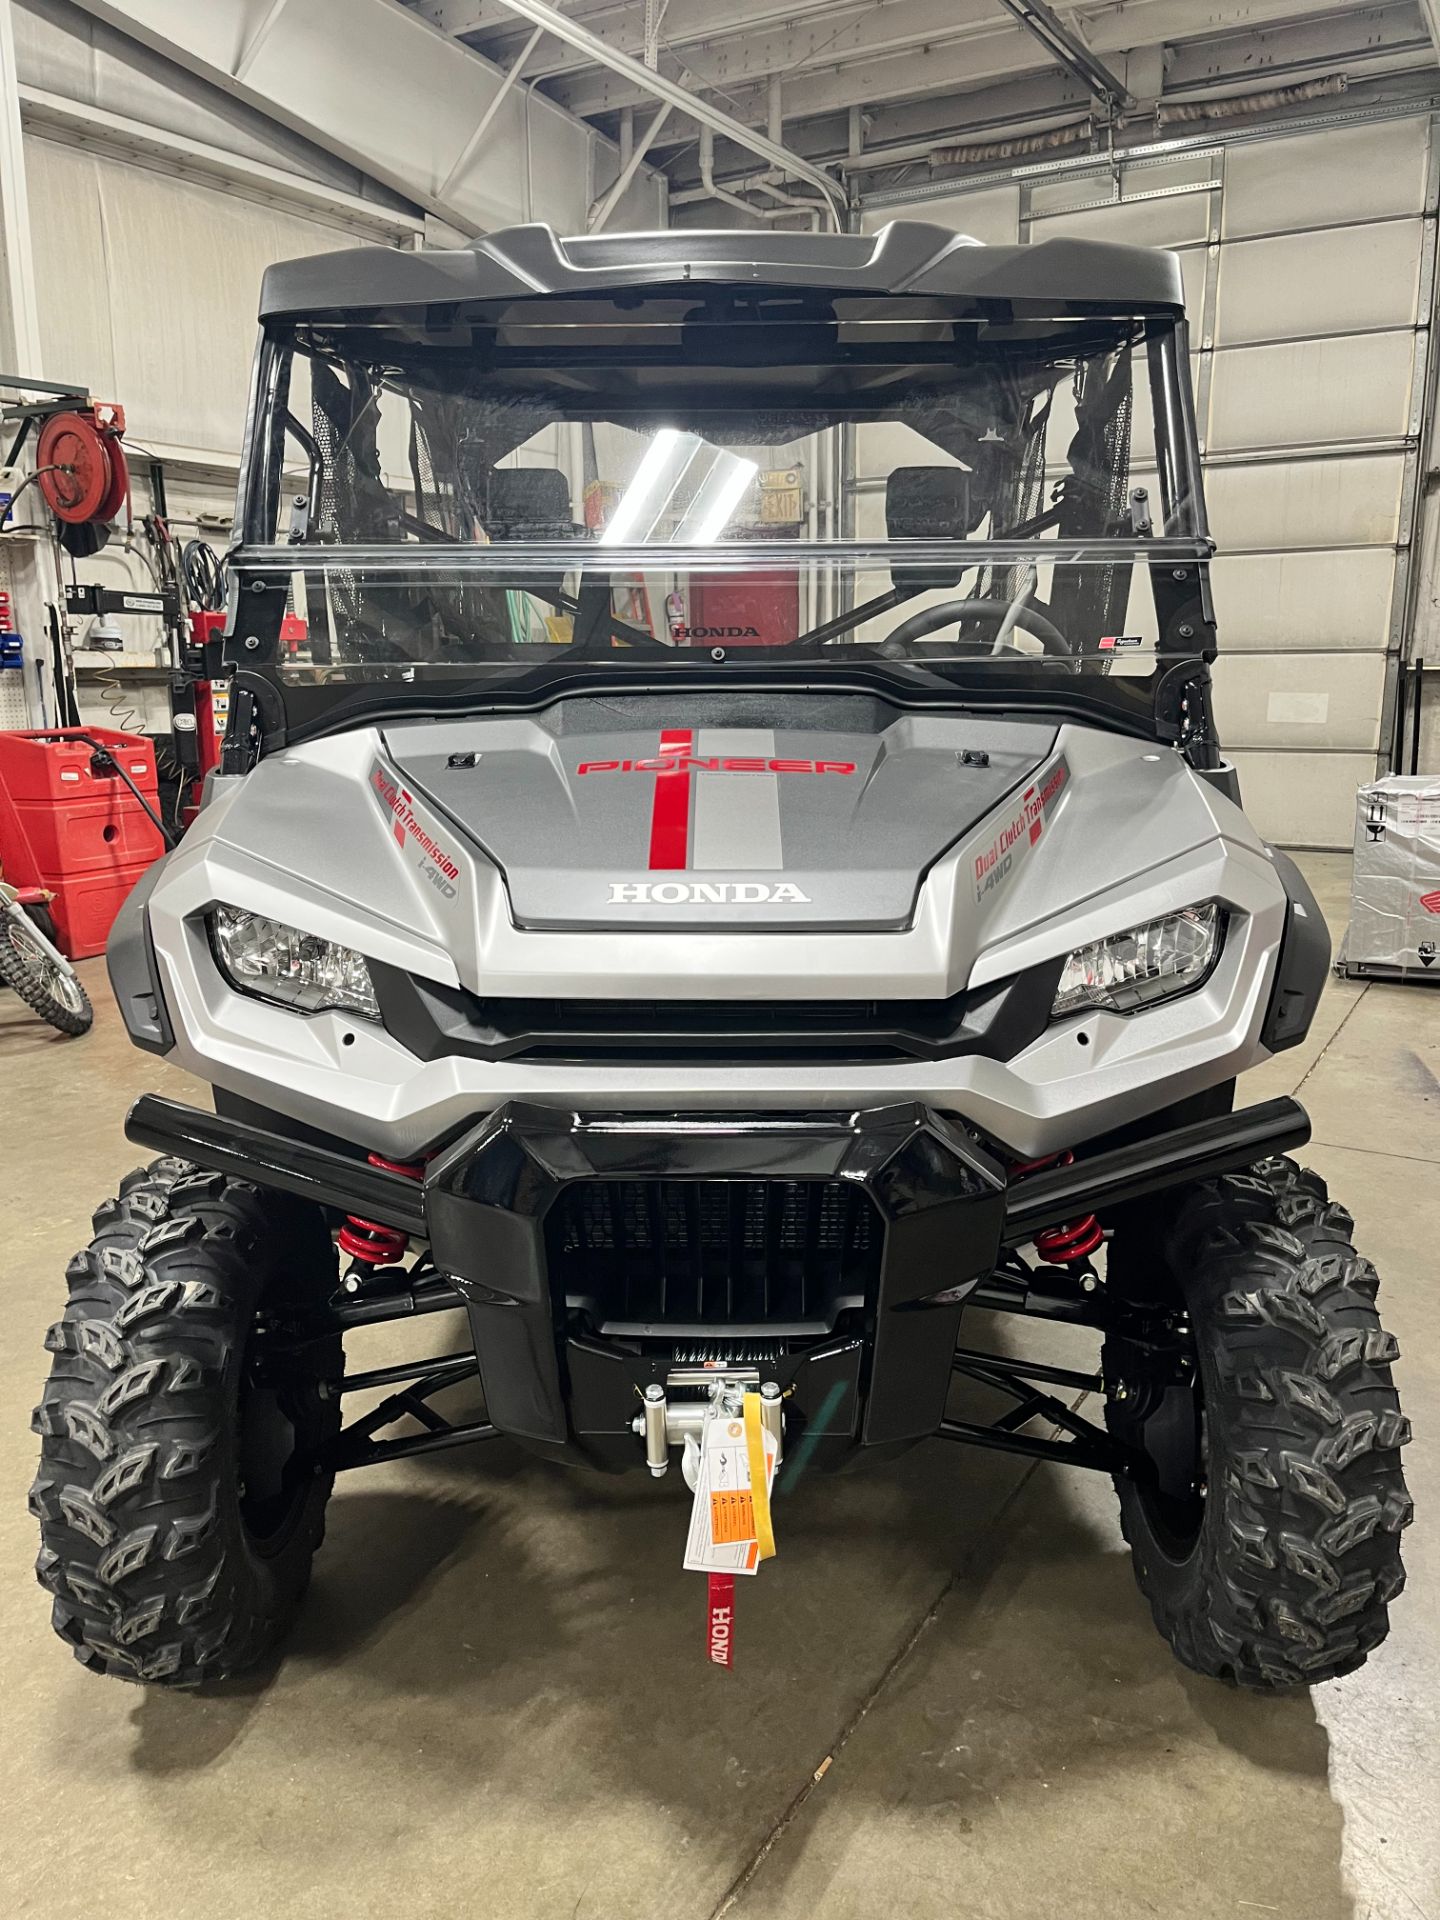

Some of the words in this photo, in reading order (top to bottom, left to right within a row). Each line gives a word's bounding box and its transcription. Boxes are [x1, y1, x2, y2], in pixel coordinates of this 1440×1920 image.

[673, 626, 760, 638] HONDA
[576, 757, 857, 776] PIONEER
[975, 840, 998, 881] Dual
[999, 812, 1026, 855] Clutch
[1023, 766, 1066, 824] Transmission
[402, 809, 459, 881] Transmission
[418, 857, 457, 899] i-4WD
[606, 882, 812, 904] HONDA
[976, 853, 1012, 903] i-4WD
